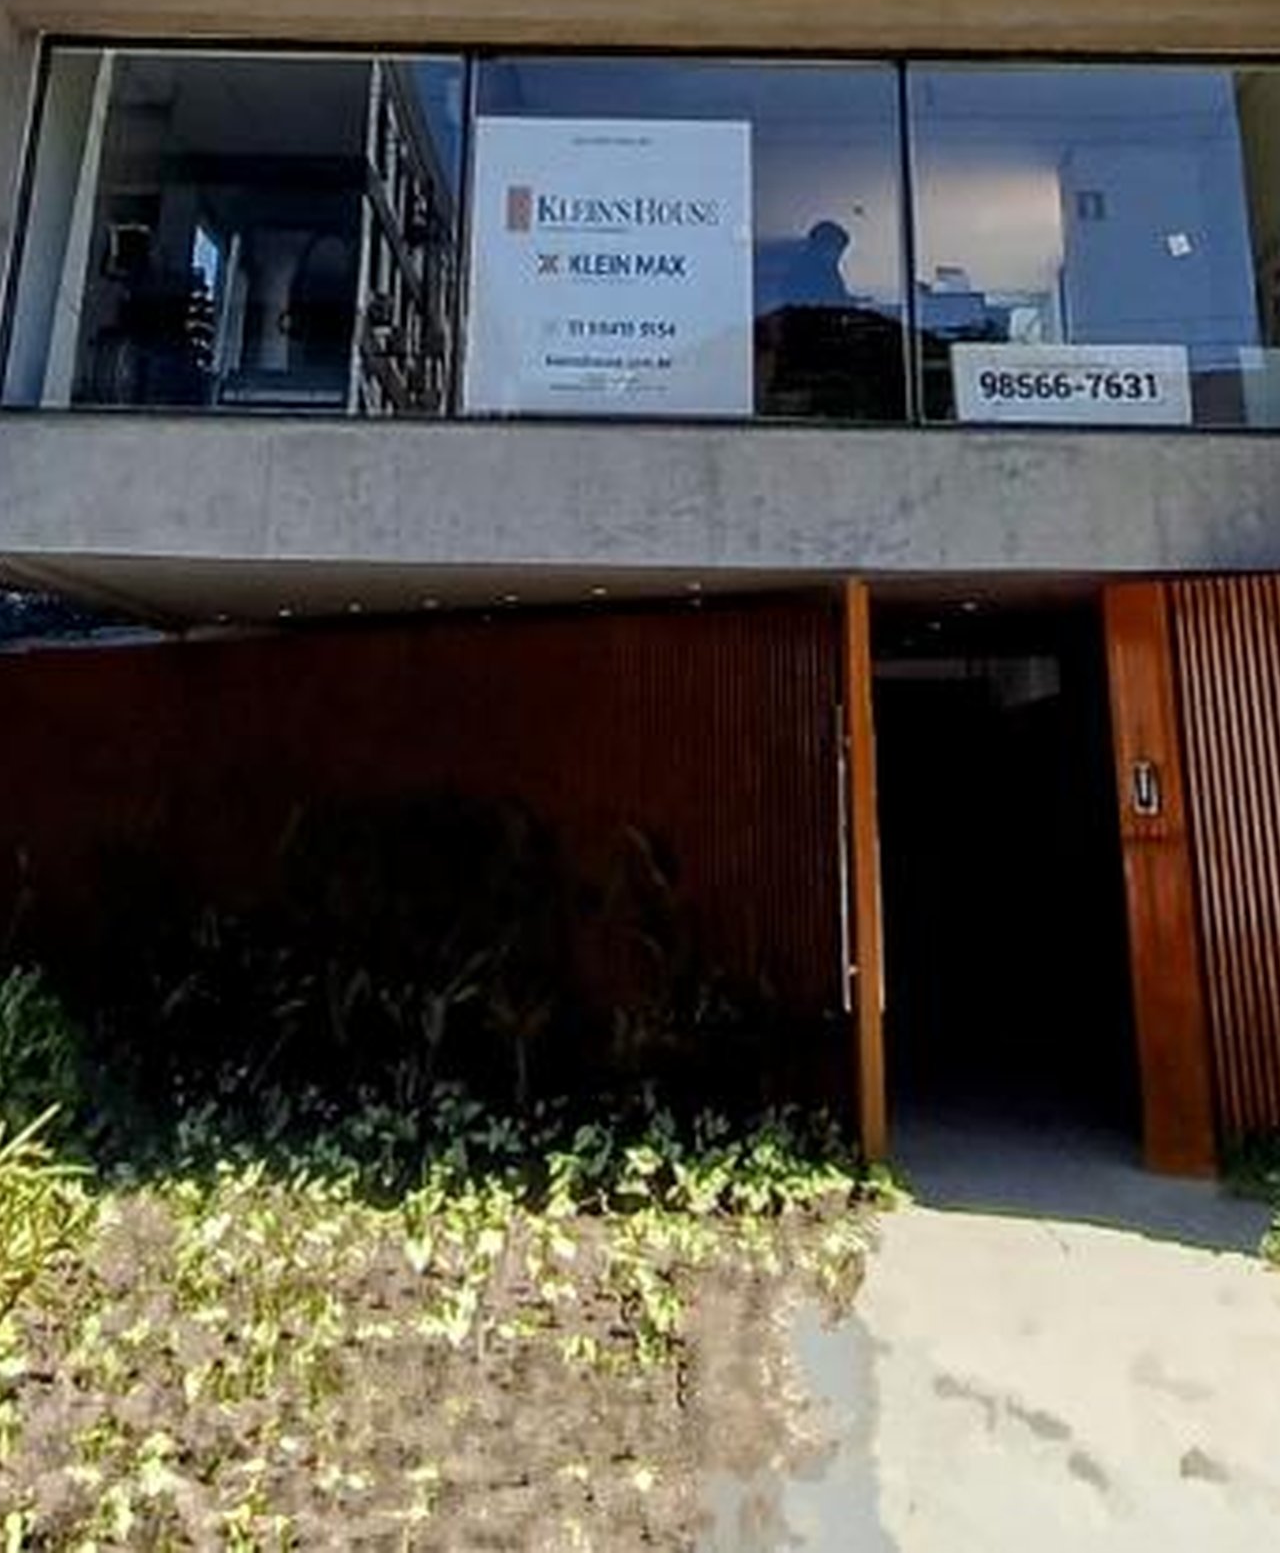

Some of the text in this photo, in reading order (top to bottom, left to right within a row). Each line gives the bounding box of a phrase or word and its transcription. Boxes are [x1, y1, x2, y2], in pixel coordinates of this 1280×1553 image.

[569, 255, 686, 277] KLEIN MAX
[978, 370, 1158, 398] 98566-7631
